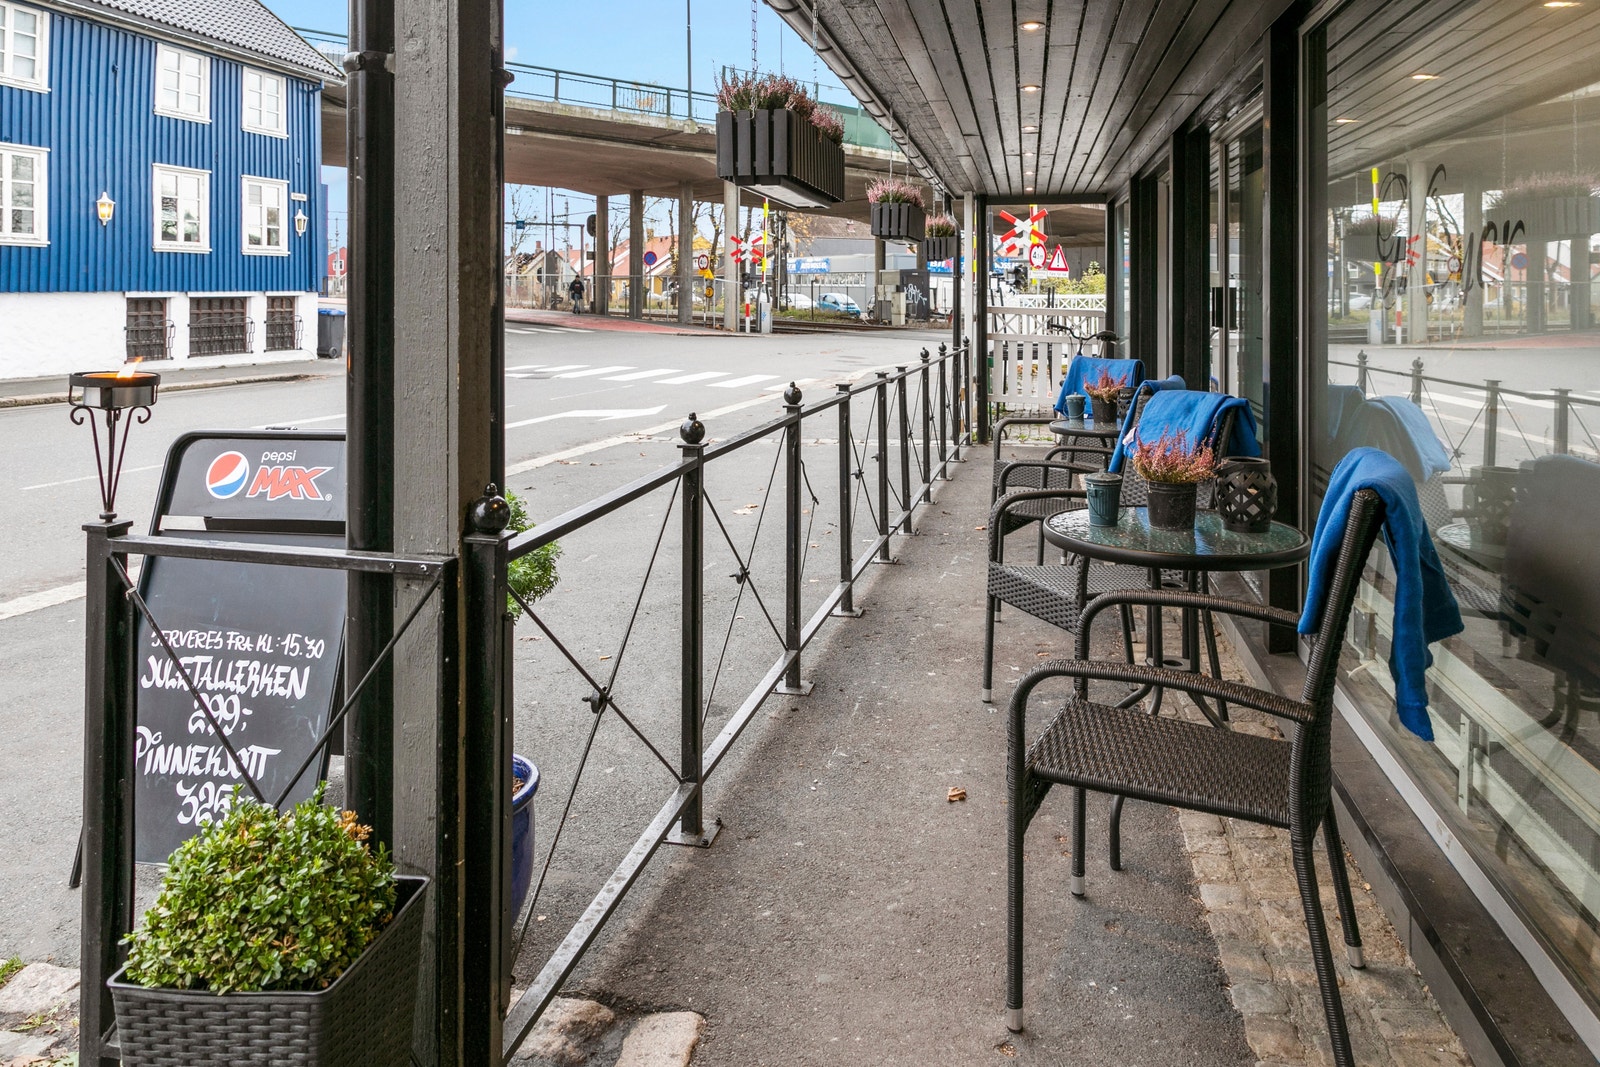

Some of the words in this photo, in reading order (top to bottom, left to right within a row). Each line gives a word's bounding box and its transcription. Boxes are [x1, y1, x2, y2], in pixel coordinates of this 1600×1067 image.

[261, 450, 297, 464] pepsi
[246, 466, 333, 500] MAX
[226, 631, 254, 652] FRA
